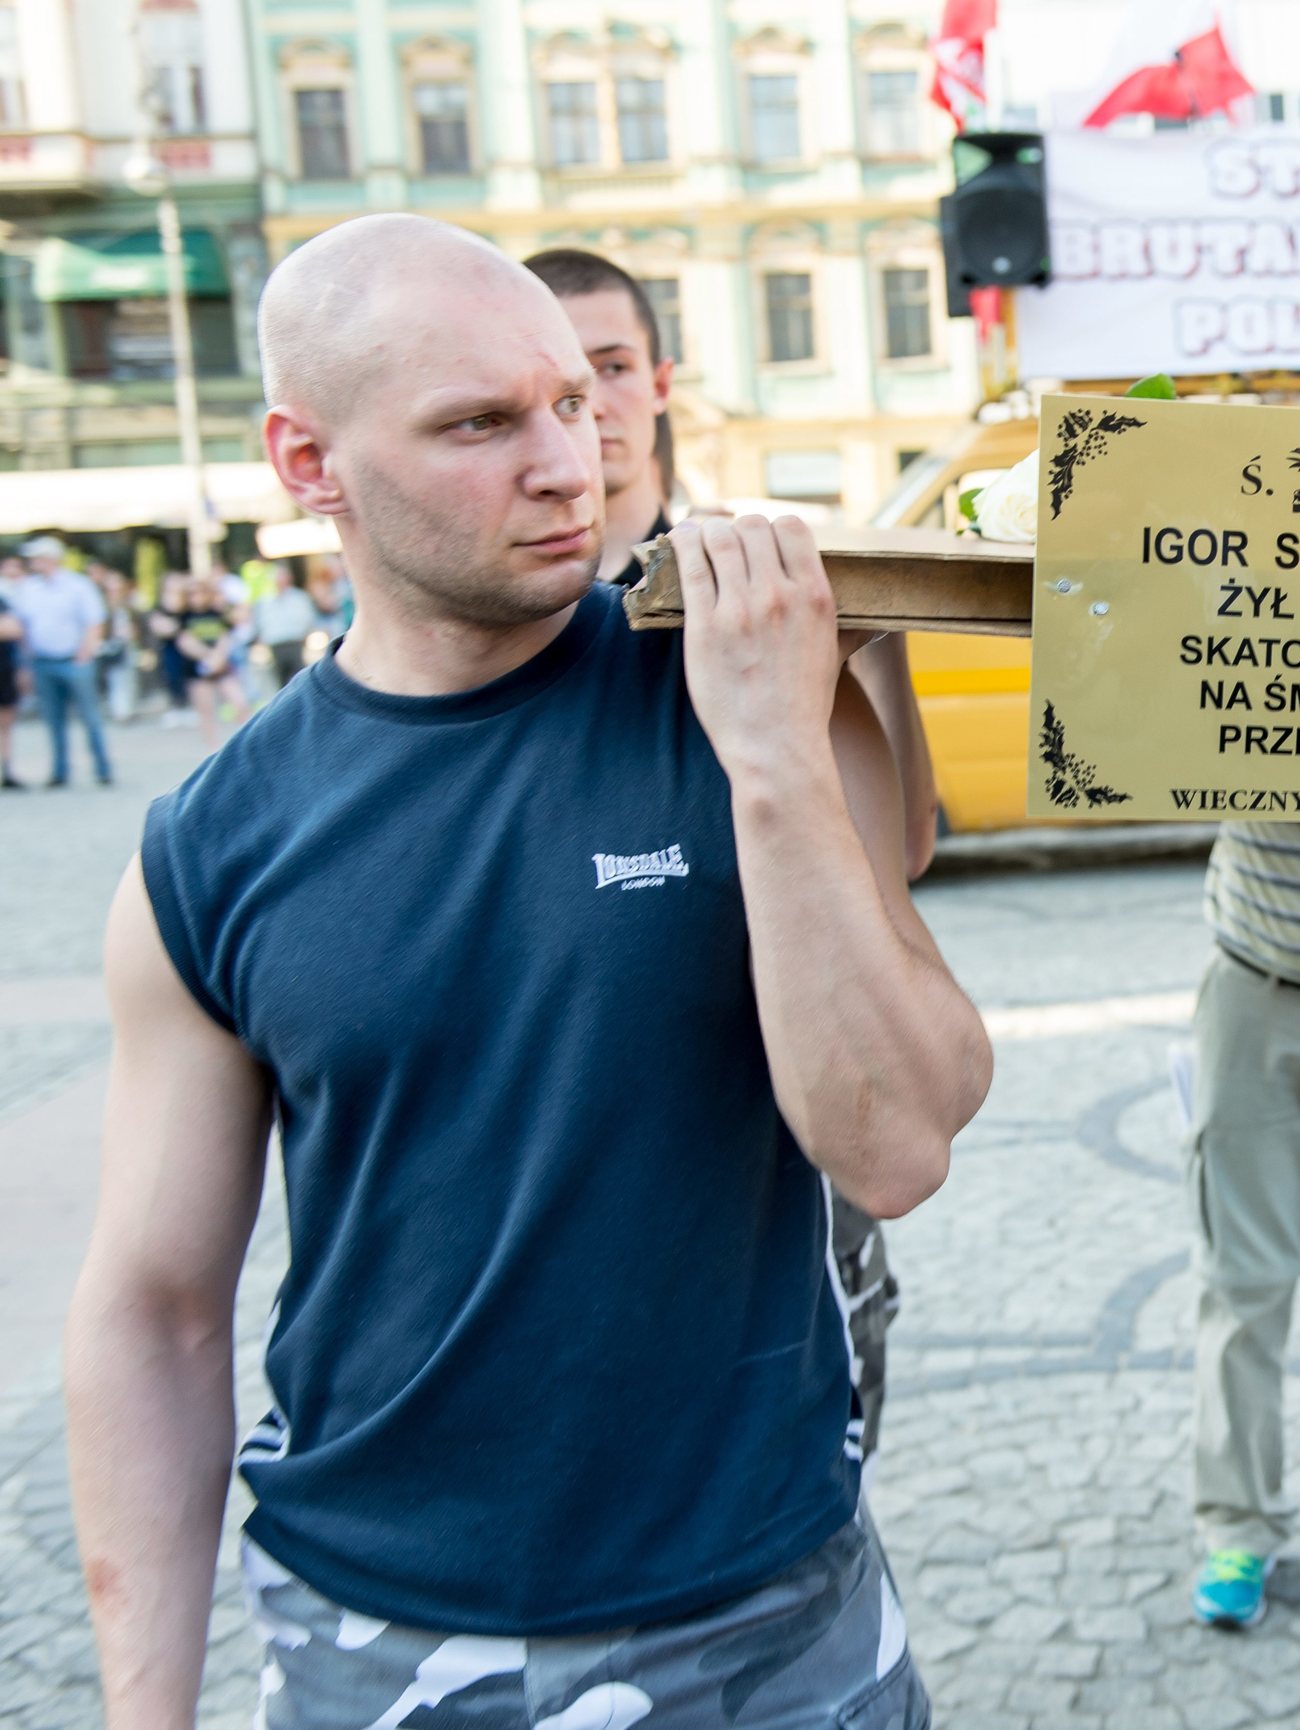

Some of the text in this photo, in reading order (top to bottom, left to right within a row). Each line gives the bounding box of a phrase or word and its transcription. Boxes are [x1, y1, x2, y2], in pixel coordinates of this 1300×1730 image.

[1241, 456, 1274, 496] Ś.
[1142, 526, 1250, 568] IGOR
[1217, 578, 1295, 620] ŻYŁ
[1200, 680, 1253, 711] NA
[591, 843, 689, 889] LONSDALE
